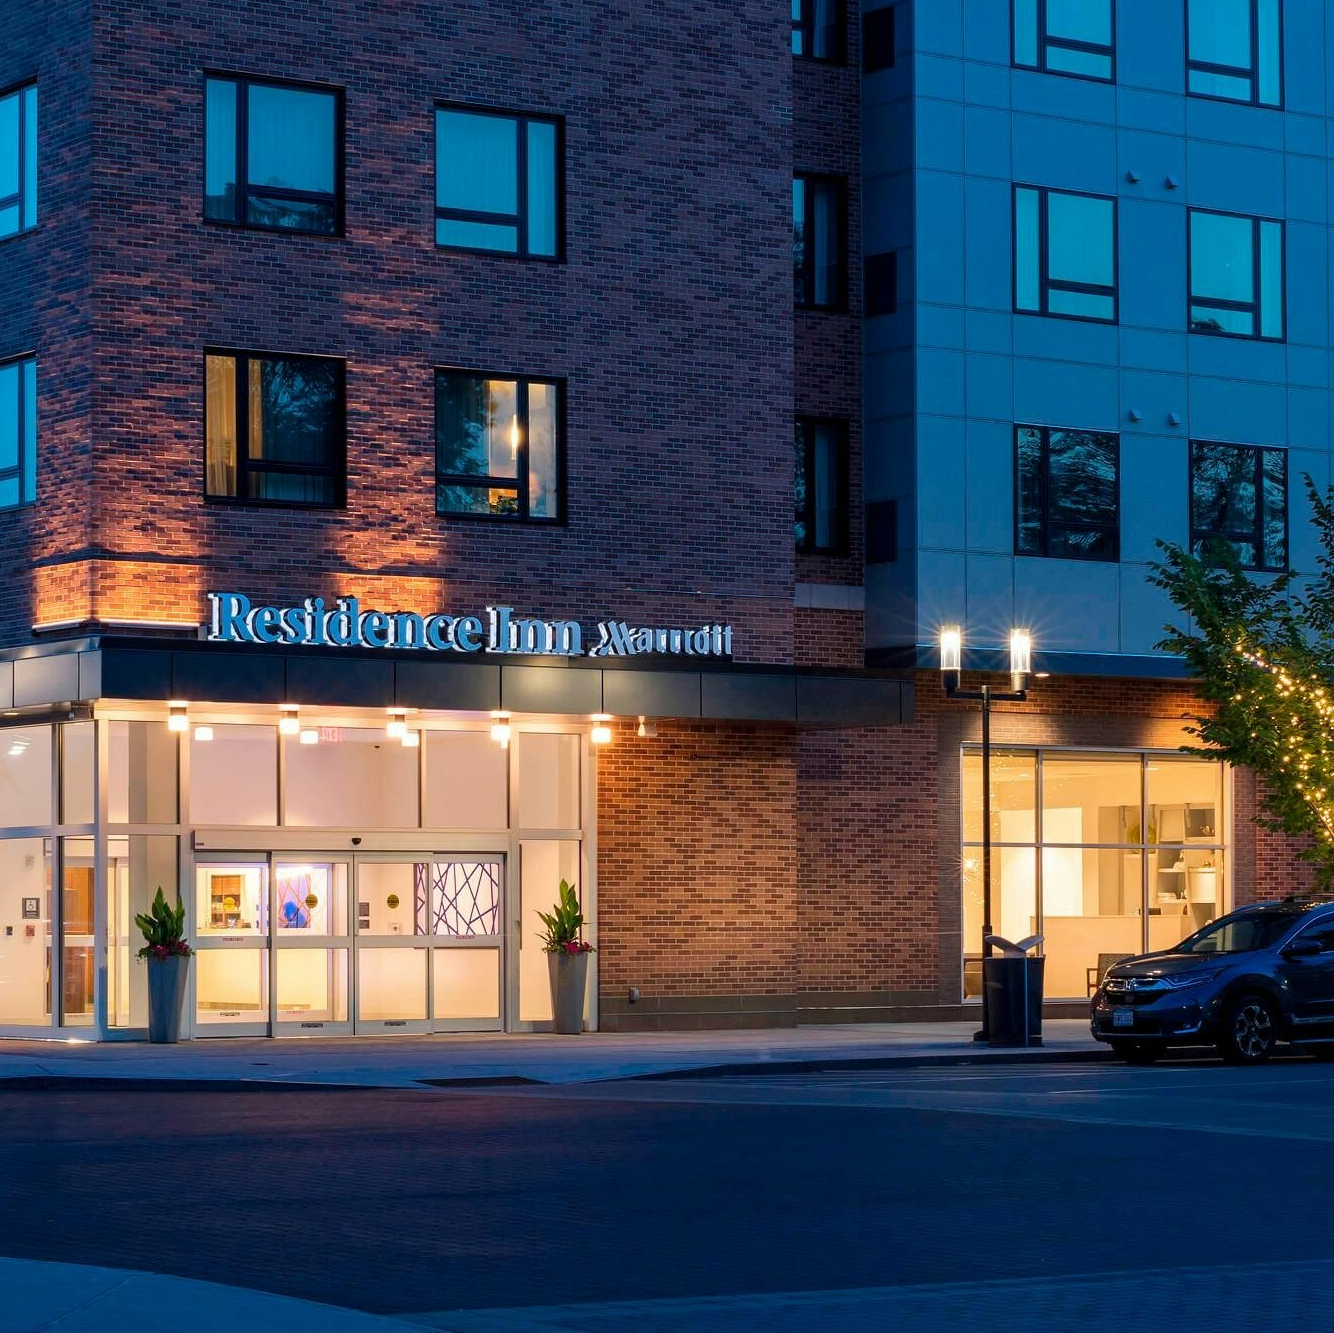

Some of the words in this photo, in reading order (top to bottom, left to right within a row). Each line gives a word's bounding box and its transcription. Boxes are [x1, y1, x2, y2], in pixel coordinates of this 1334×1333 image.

[207, 591, 483, 652] Residence
[487, 604, 583, 655] Inn
[590, 619, 733, 657] Marriott
